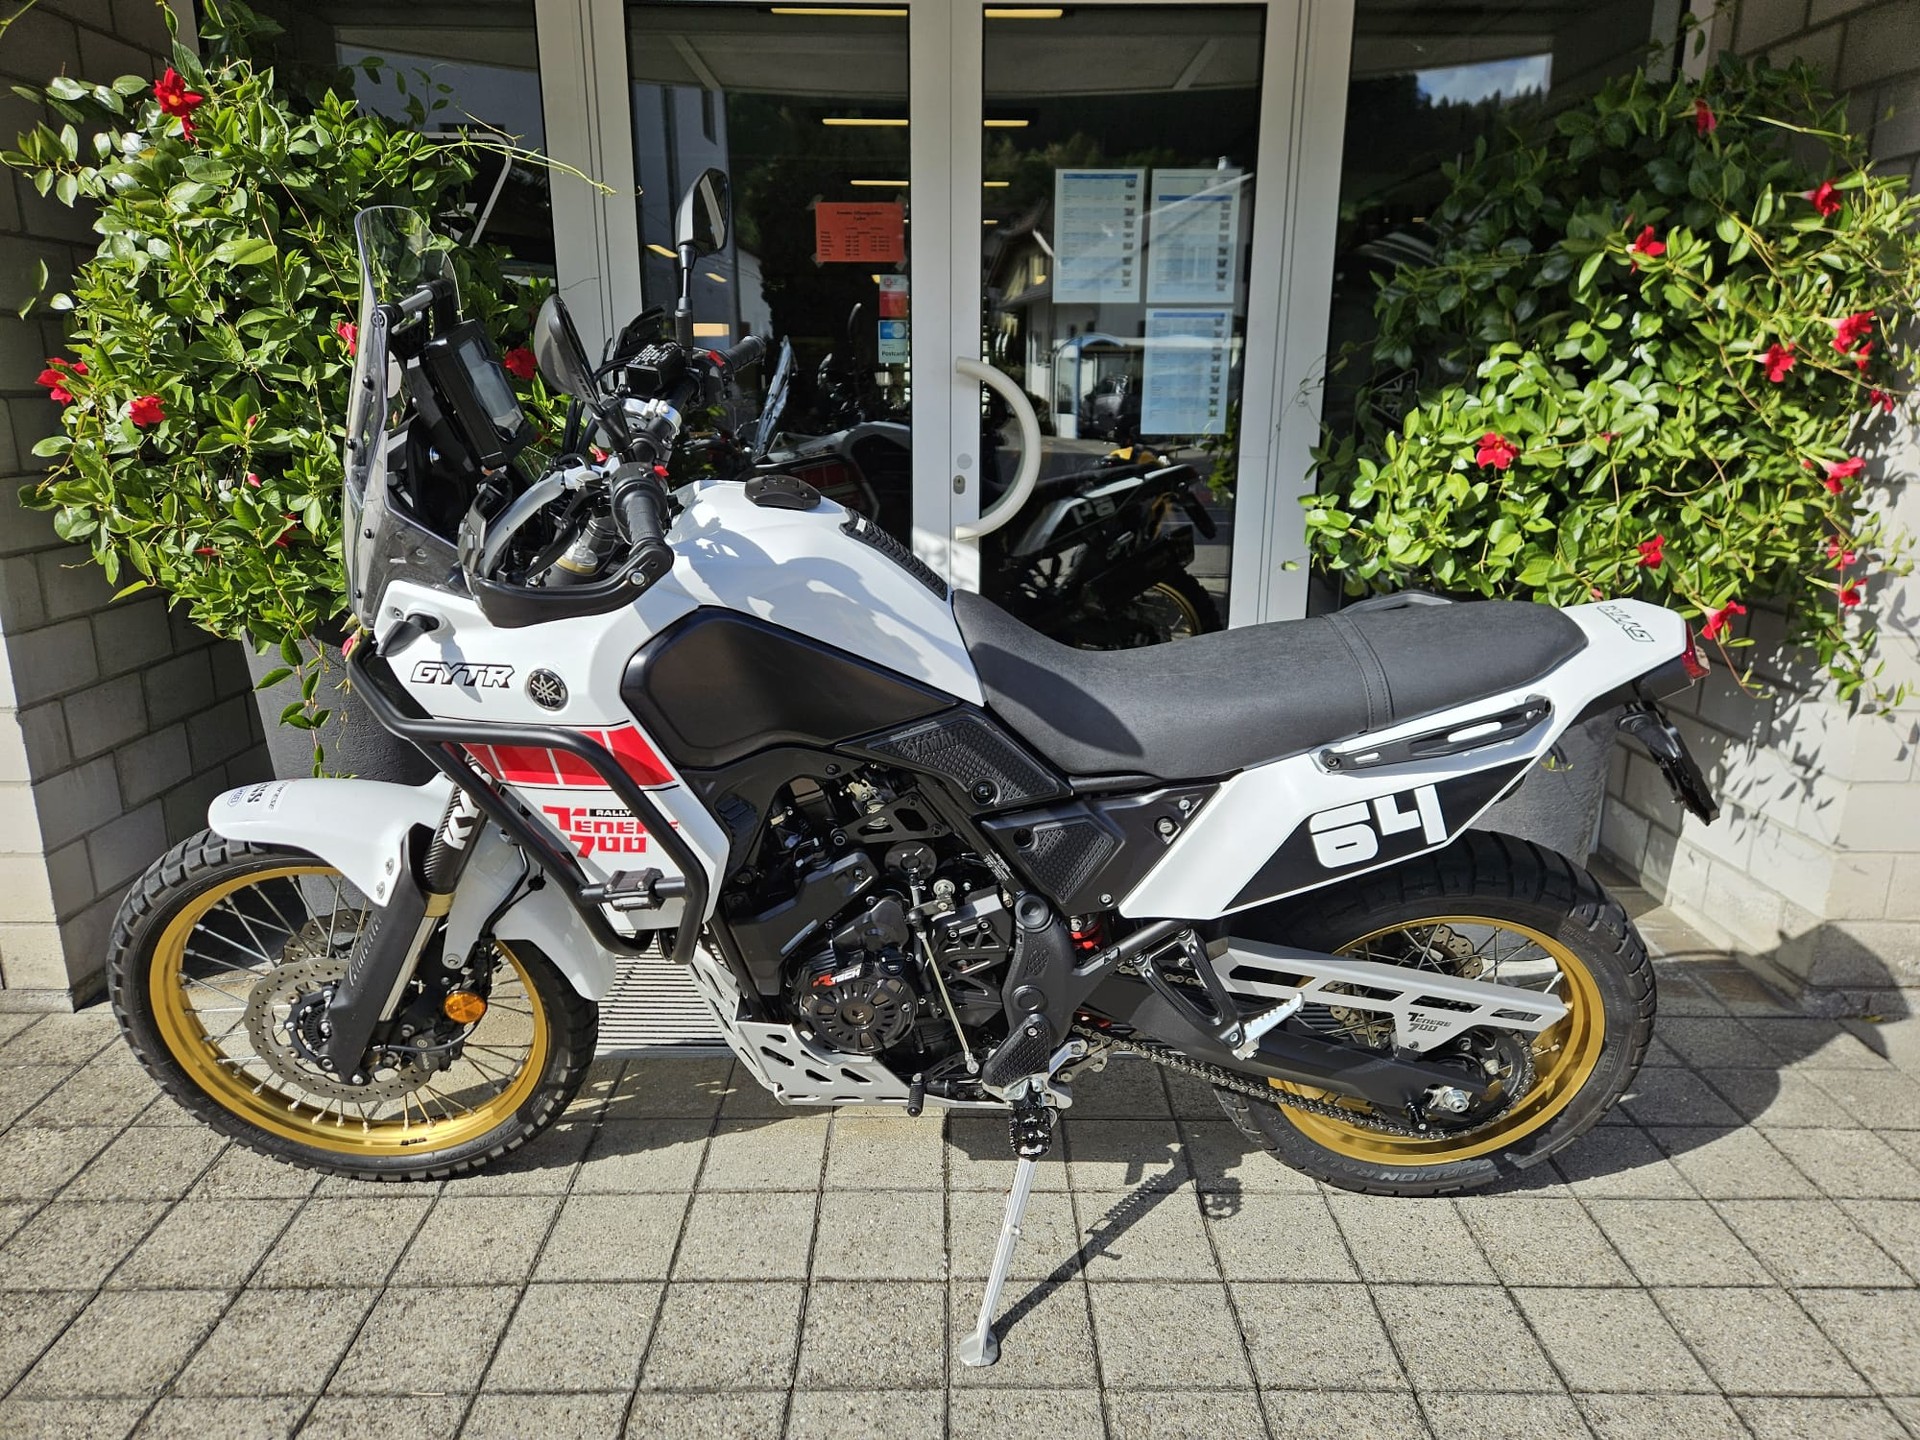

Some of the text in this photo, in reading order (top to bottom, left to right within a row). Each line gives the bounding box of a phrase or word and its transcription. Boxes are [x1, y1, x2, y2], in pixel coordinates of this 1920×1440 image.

[410, 660, 515, 688] GYTR
[596, 809, 632, 817] RALLY
[1309, 784, 1448, 868] 64
[569, 834, 647, 859] 700
[1407, 1023, 1438, 1033] 700
